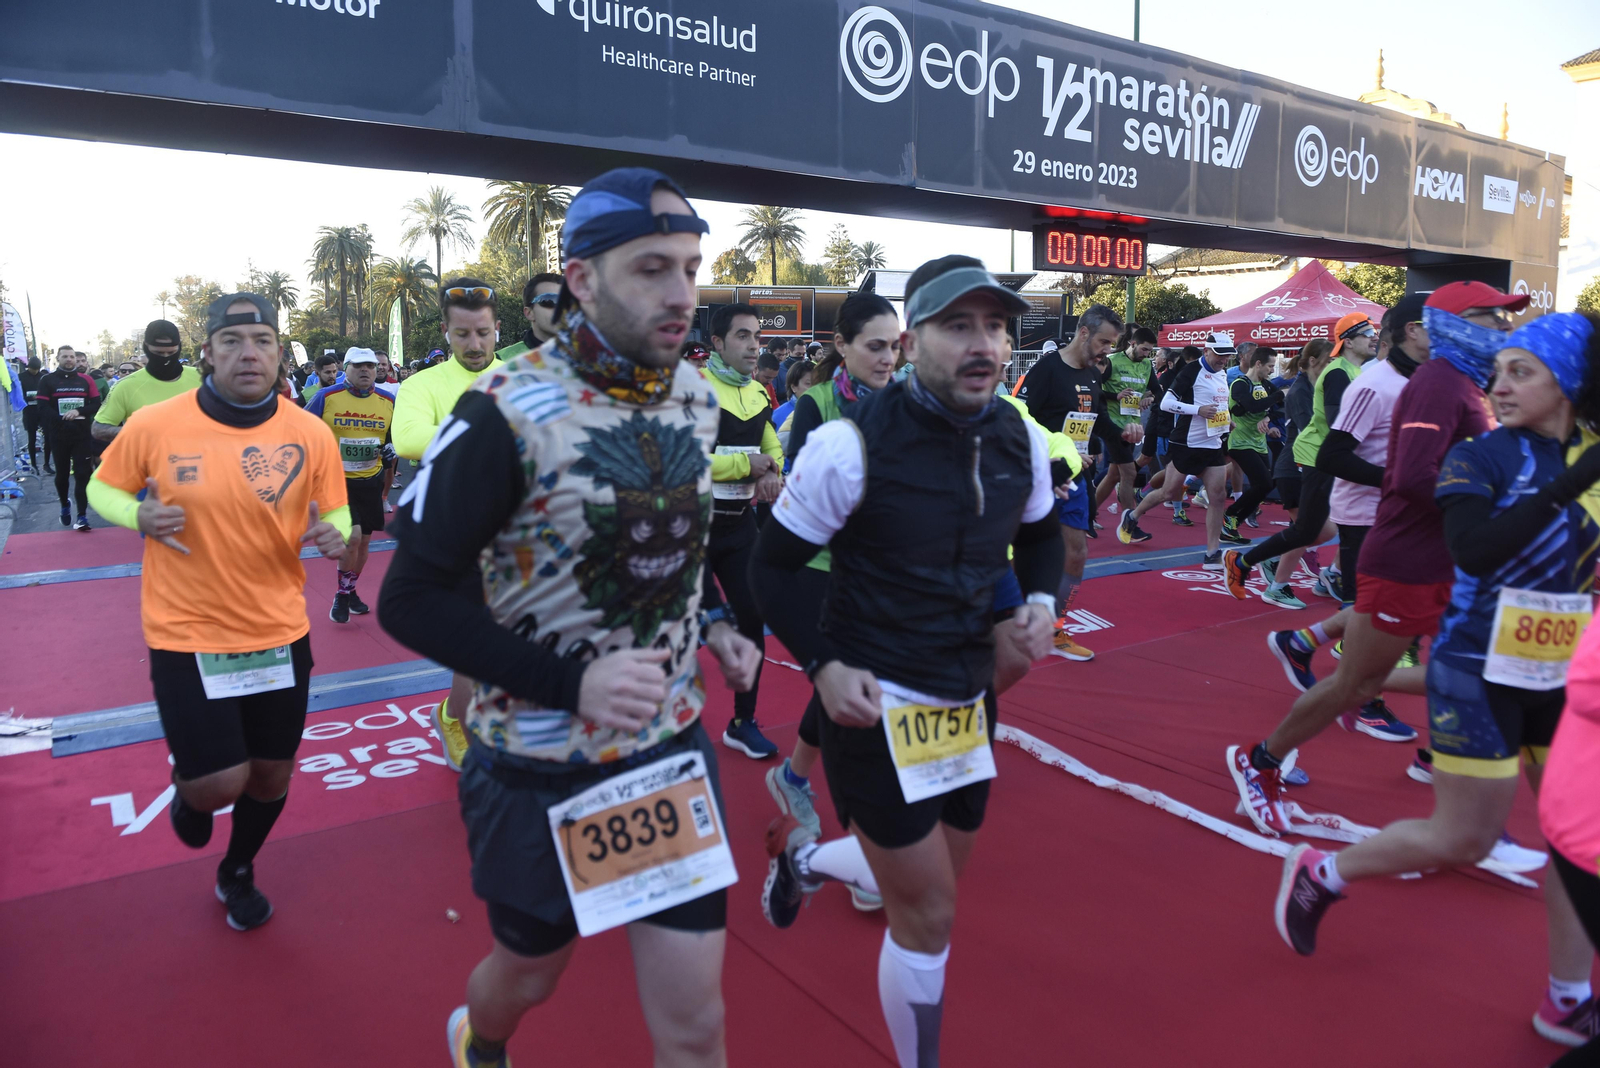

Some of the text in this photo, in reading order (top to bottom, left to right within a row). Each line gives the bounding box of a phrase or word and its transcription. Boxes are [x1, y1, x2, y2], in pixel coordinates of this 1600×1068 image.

[276, 0, 381, 19] otor
[568, 0, 757, 52] quirónsalud
[602, 45, 757, 87] Healthcare Partner
[919, 30, 1020, 118] edp
[1083, 65, 1230, 130] maratón
[1122, 114, 1232, 169] sevilla
[1012, 149, 1138, 189] 29 enero 2023
[1331, 136, 1379, 195] edp
[1413, 164, 1466, 205] HOKA
[1530, 281, 1554, 315] edp
[1250, 322, 1329, 342] alssport.es
[333, 417, 386, 429] runners
[1068, 422, 1088, 435] 9743
[345, 446, 371, 457] 6319
[1514, 615, 1577, 647] 8609
[897, 703, 977, 747] 10757
[581, 798, 680, 863] 3839
